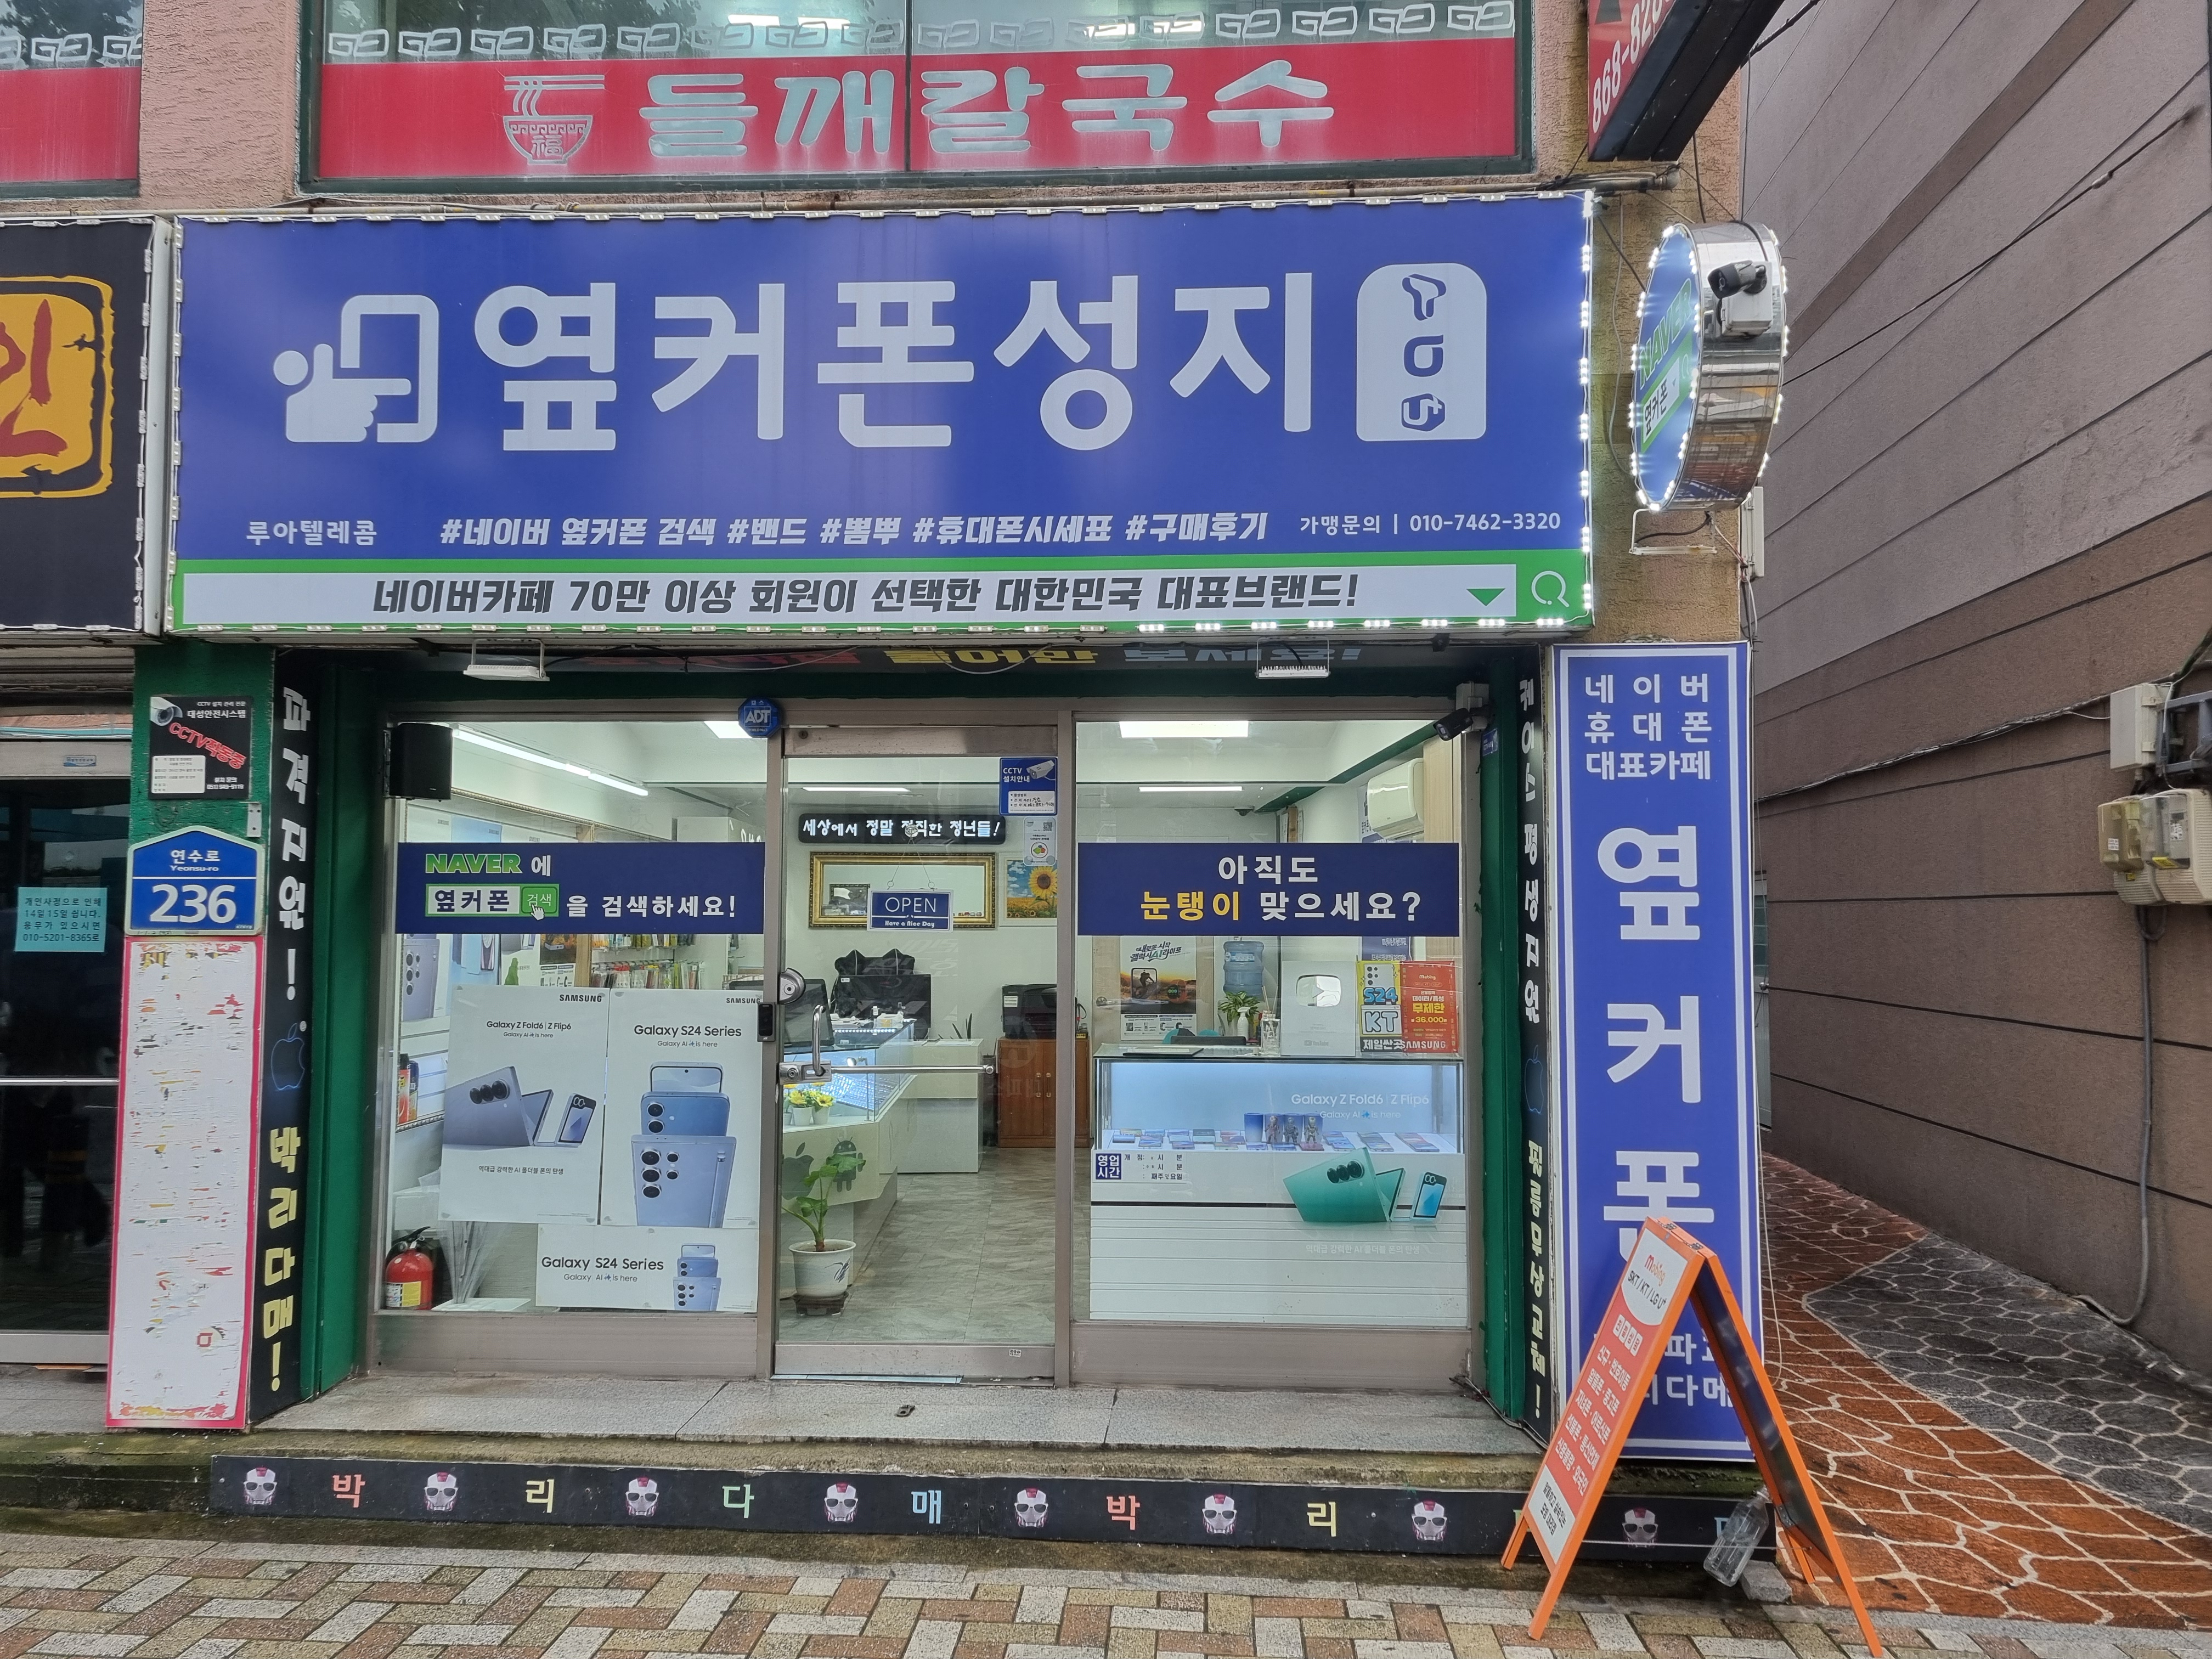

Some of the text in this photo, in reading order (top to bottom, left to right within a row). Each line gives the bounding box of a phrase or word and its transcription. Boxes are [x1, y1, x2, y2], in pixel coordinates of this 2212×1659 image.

[639, 59, 1334, 157] 들깨칼국수
[1639, 278, 1692, 401] NAVER
[475, 272, 1312, 450] 옆커폰성지
[246, 520, 377, 546] 루아텔레콤
[440, 512, 1268, 546] #네이버 옆커폰 검색 #밴드 #뽐뿌 #휴대폰시세표 #구매후기
[1300, 512, 1561, 535] 가맹문의 010-7462-3320
[373, 573, 1358, 614] 네이버카페 70만 이상 회원이 선택한 대한민국 대표브랜드!
[1585, 673, 1708, 703] 네이버
[187, 710, 246, 719] 대성안전시스템
[745, 710, 771, 723] ADT
[1584, 712, 1712, 743] 휴대폰
[169, 722, 247, 769] CCTV작동중
[1585, 751, 1711, 780] 대표카페
[803, 819, 857, 837] 세상에서
[866, 819, 894, 837] 정말
[950, 820, 1000, 838] 청년들!
[170, 849, 221, 865] 연수로
[425, 853, 551, 877] NAVER 에
[1218, 855, 1319, 884] 아직도
[24, 898, 102, 907] 개인사정으로 인해
[149, 883, 237, 924] 236
[434, 889, 510, 912] 옆커폰
[566, 895, 588, 918] 을
[602, 894, 736, 918] 검색하세요!
[885, 897, 936, 913] OPEN
[1141, 891, 1421, 922] 눈탱이 맞으세요?
[25, 910, 45, 918] 14일
[48, 910, 68, 918] 15일
[24, 921, 100, 930] 용무가 있으시면
[559, 994, 602, 1002] SAMSUNG
[1363, 987, 1398, 1005] S24
[1413, 1002, 1445, 1014] 무제한
[487, 1020, 516, 1030] Galaxy
[554, 1023, 572, 1031] Flip6
[634, 1025, 742, 1038] Galaxy S24 Series
[1365, 1011, 1399, 1032] KT
[1363, 1039, 1403, 1050] 제일싼곳
[1401, 1041, 1447, 1049] SAMSUNG
[1291, 1093, 1429, 1108] Galaxy Z Fold6 Z Flip6
[1320, 1110, 1351, 1120] Galaxy
[1097, 1155, 1120, 1167] 영업
[1097, 1167, 1120, 1178] 시간
[263, 1126, 301, 1391] 박리다매!
[1306, 1244, 1328, 1254] 역대급
[1330, 1245, 1352, 1254] 강력한
[541, 1256, 664, 1271] Galaxy S24 Series
[563, 1273, 592, 1282] Galaxy
[1628, 1270, 1640, 1282] SKT
[1640, 1281, 1650, 1294] KT
[1596, 1345, 1632, 1392] 신규 번호이동
[1590, 1410, 1612, 1446] 어르신폰
[1572, 1465, 1589, 1497] 외국인
[332, 1474, 1337, 1537] 박 리 다 매 박 리
